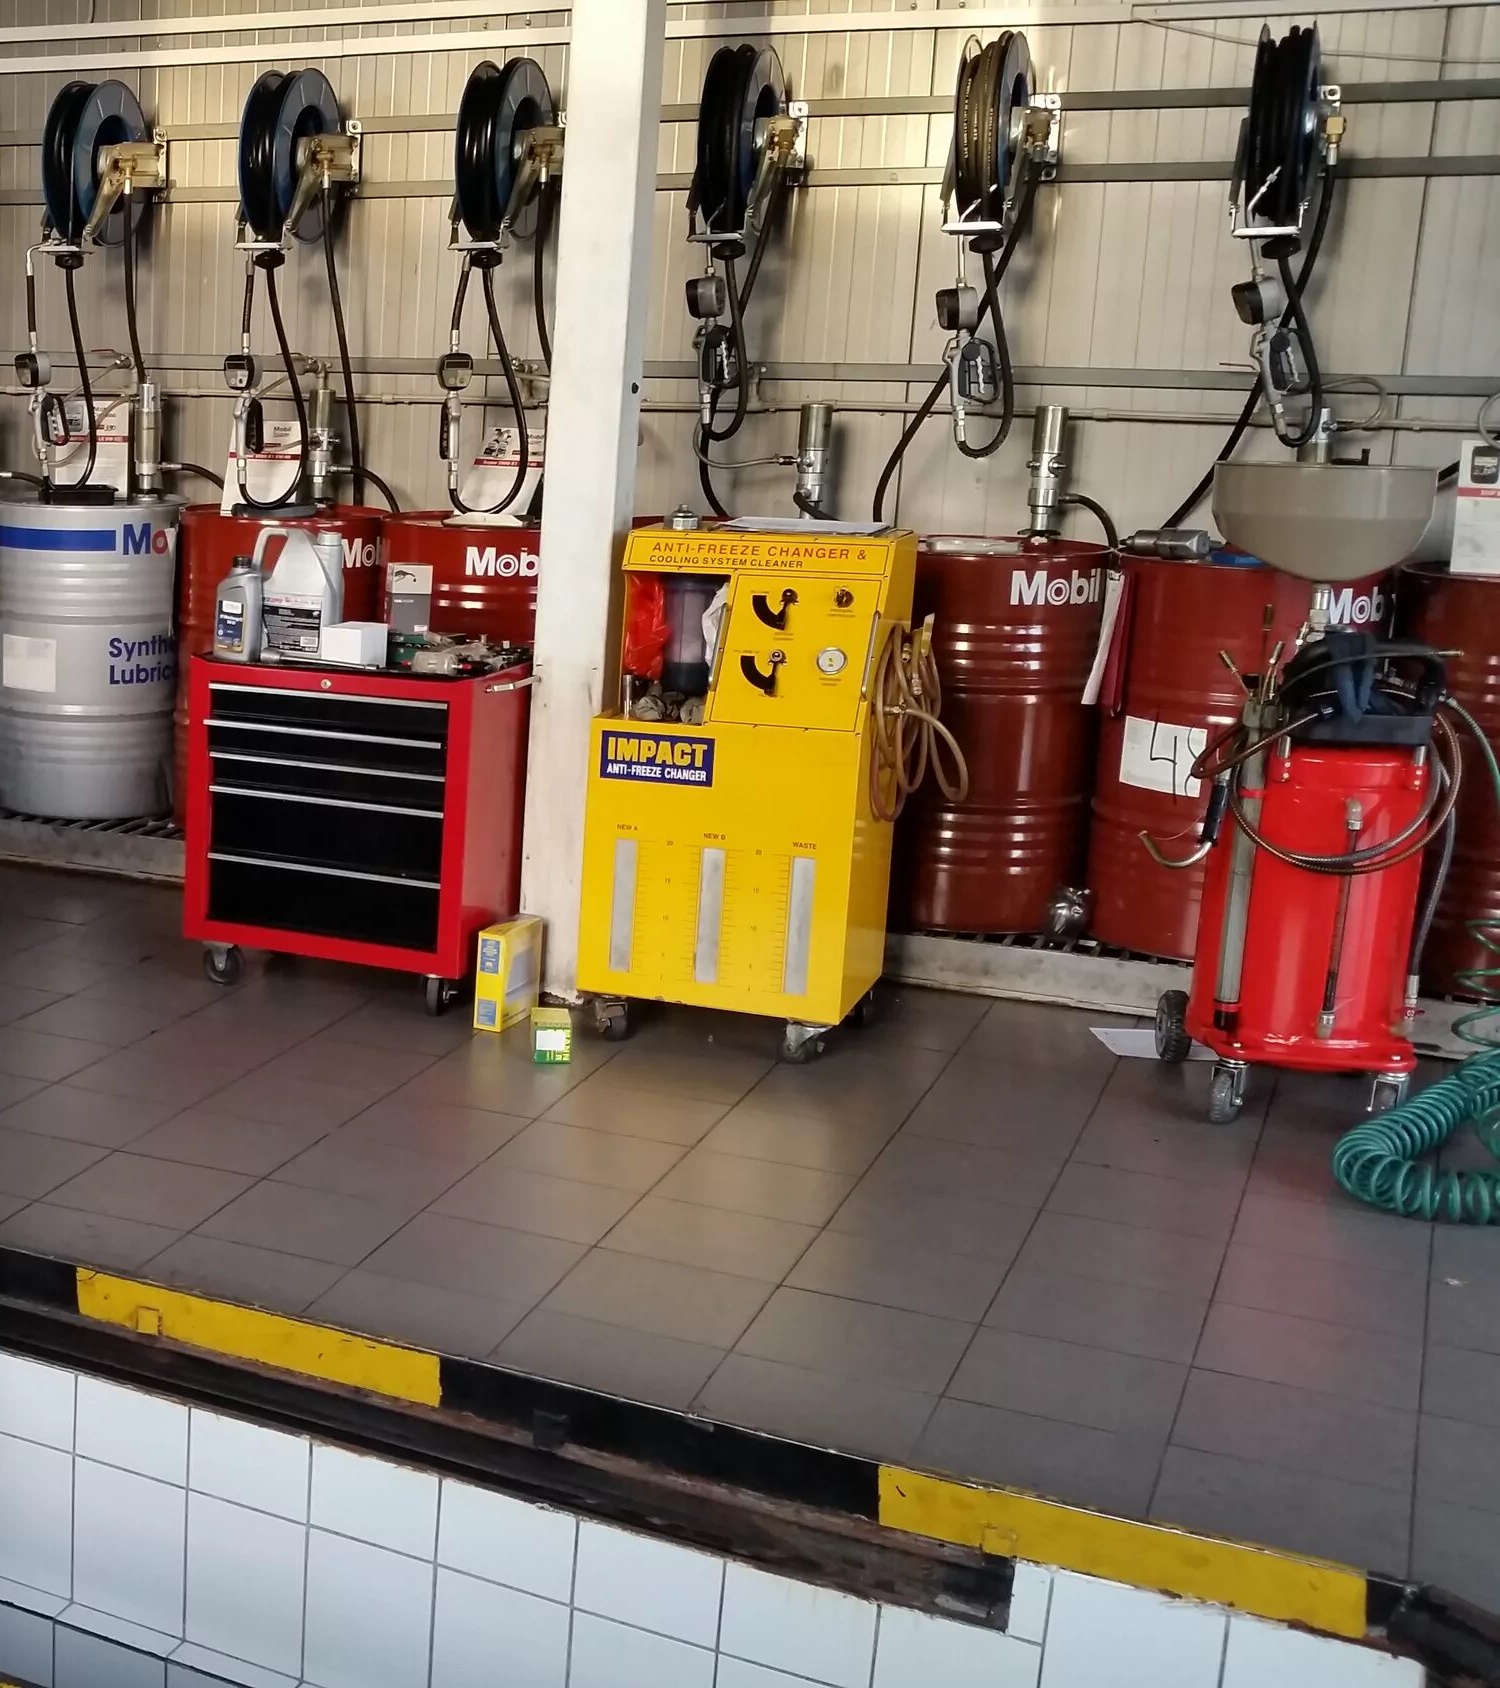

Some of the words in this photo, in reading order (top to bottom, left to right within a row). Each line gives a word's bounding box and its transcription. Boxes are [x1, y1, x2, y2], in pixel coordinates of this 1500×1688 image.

[122, 523, 168, 555] Mo
[652, 541, 760, 557] ANTI-FREEZE
[767, 546, 849, 560] CHANGER
[856, 550, 867, 560] &
[465, 547, 539, 577] Mob
[649, 554, 699, 565] COOLING
[702, 557, 747, 567] SYSTEM
[750, 559, 803, 568] CLEANER
[1010, 568, 1100, 606] Mobil
[1329, 586, 1384, 624] Mob
[109, 634, 175, 662] Synth
[607, 736, 708, 768] IMPACT
[607, 762, 662, 778] ANTI-FREEZE
[664, 767, 707, 782] CHANGER
[792, 841, 817, 850] WASTE
